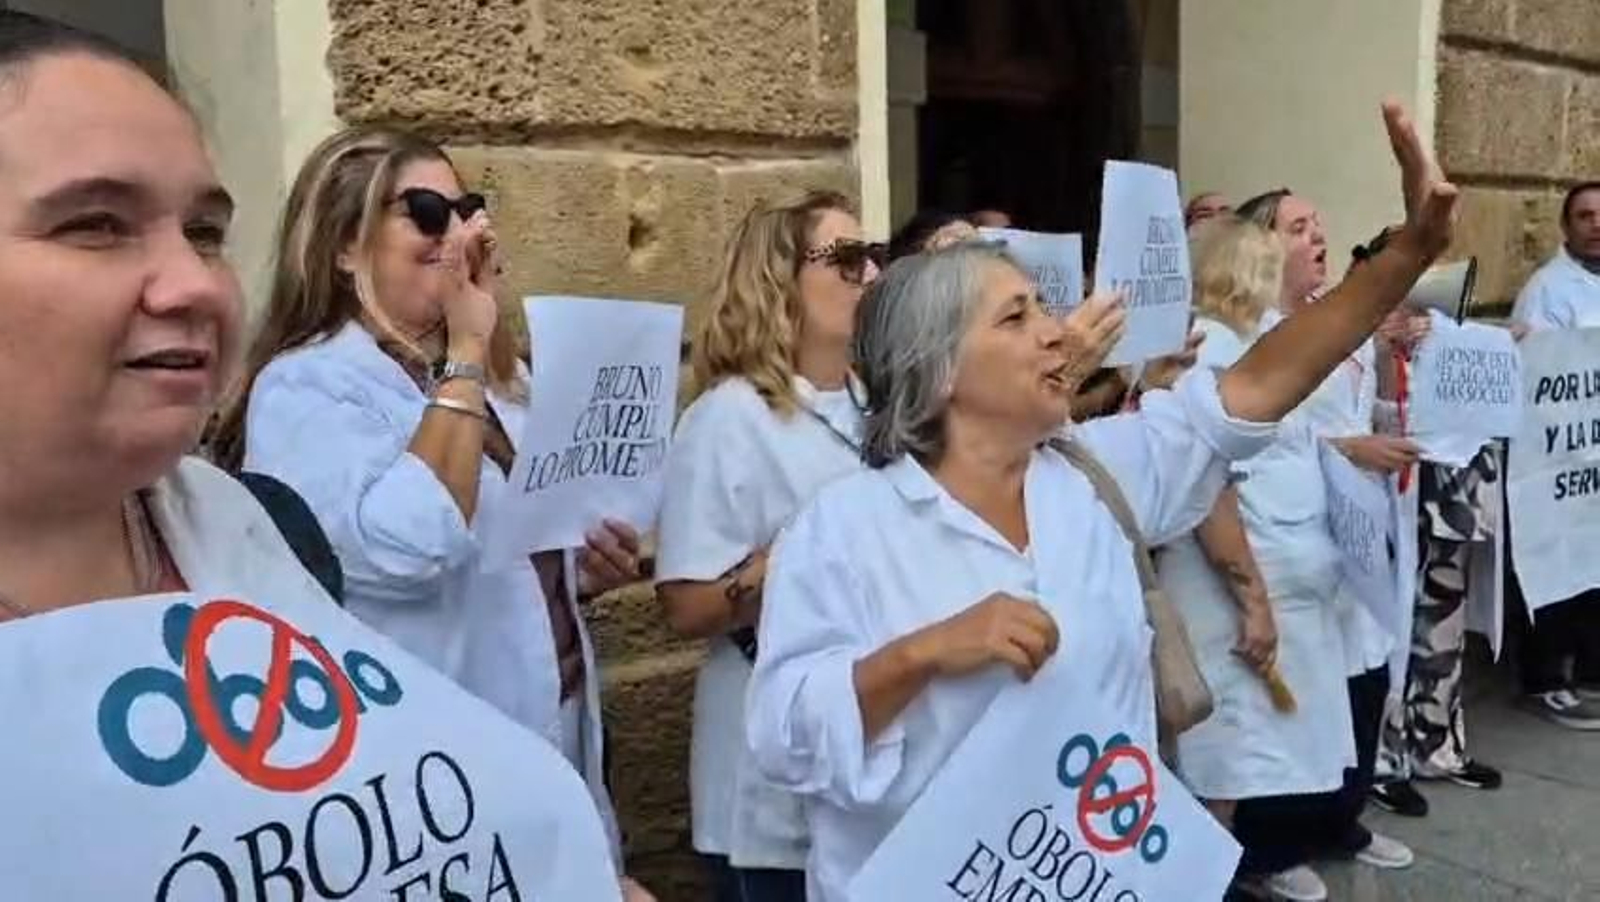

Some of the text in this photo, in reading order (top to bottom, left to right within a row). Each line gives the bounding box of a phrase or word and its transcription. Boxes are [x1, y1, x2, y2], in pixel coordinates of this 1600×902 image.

[591, 365, 662, 402] BRUNO
[1534, 374, 1579, 405] POR
[1545, 425, 1559, 454] Y
[1566, 421, 1586, 451] LA
[524, 437, 667, 493] LO PROMET
[154, 751, 475, 902] ÓBOLO
